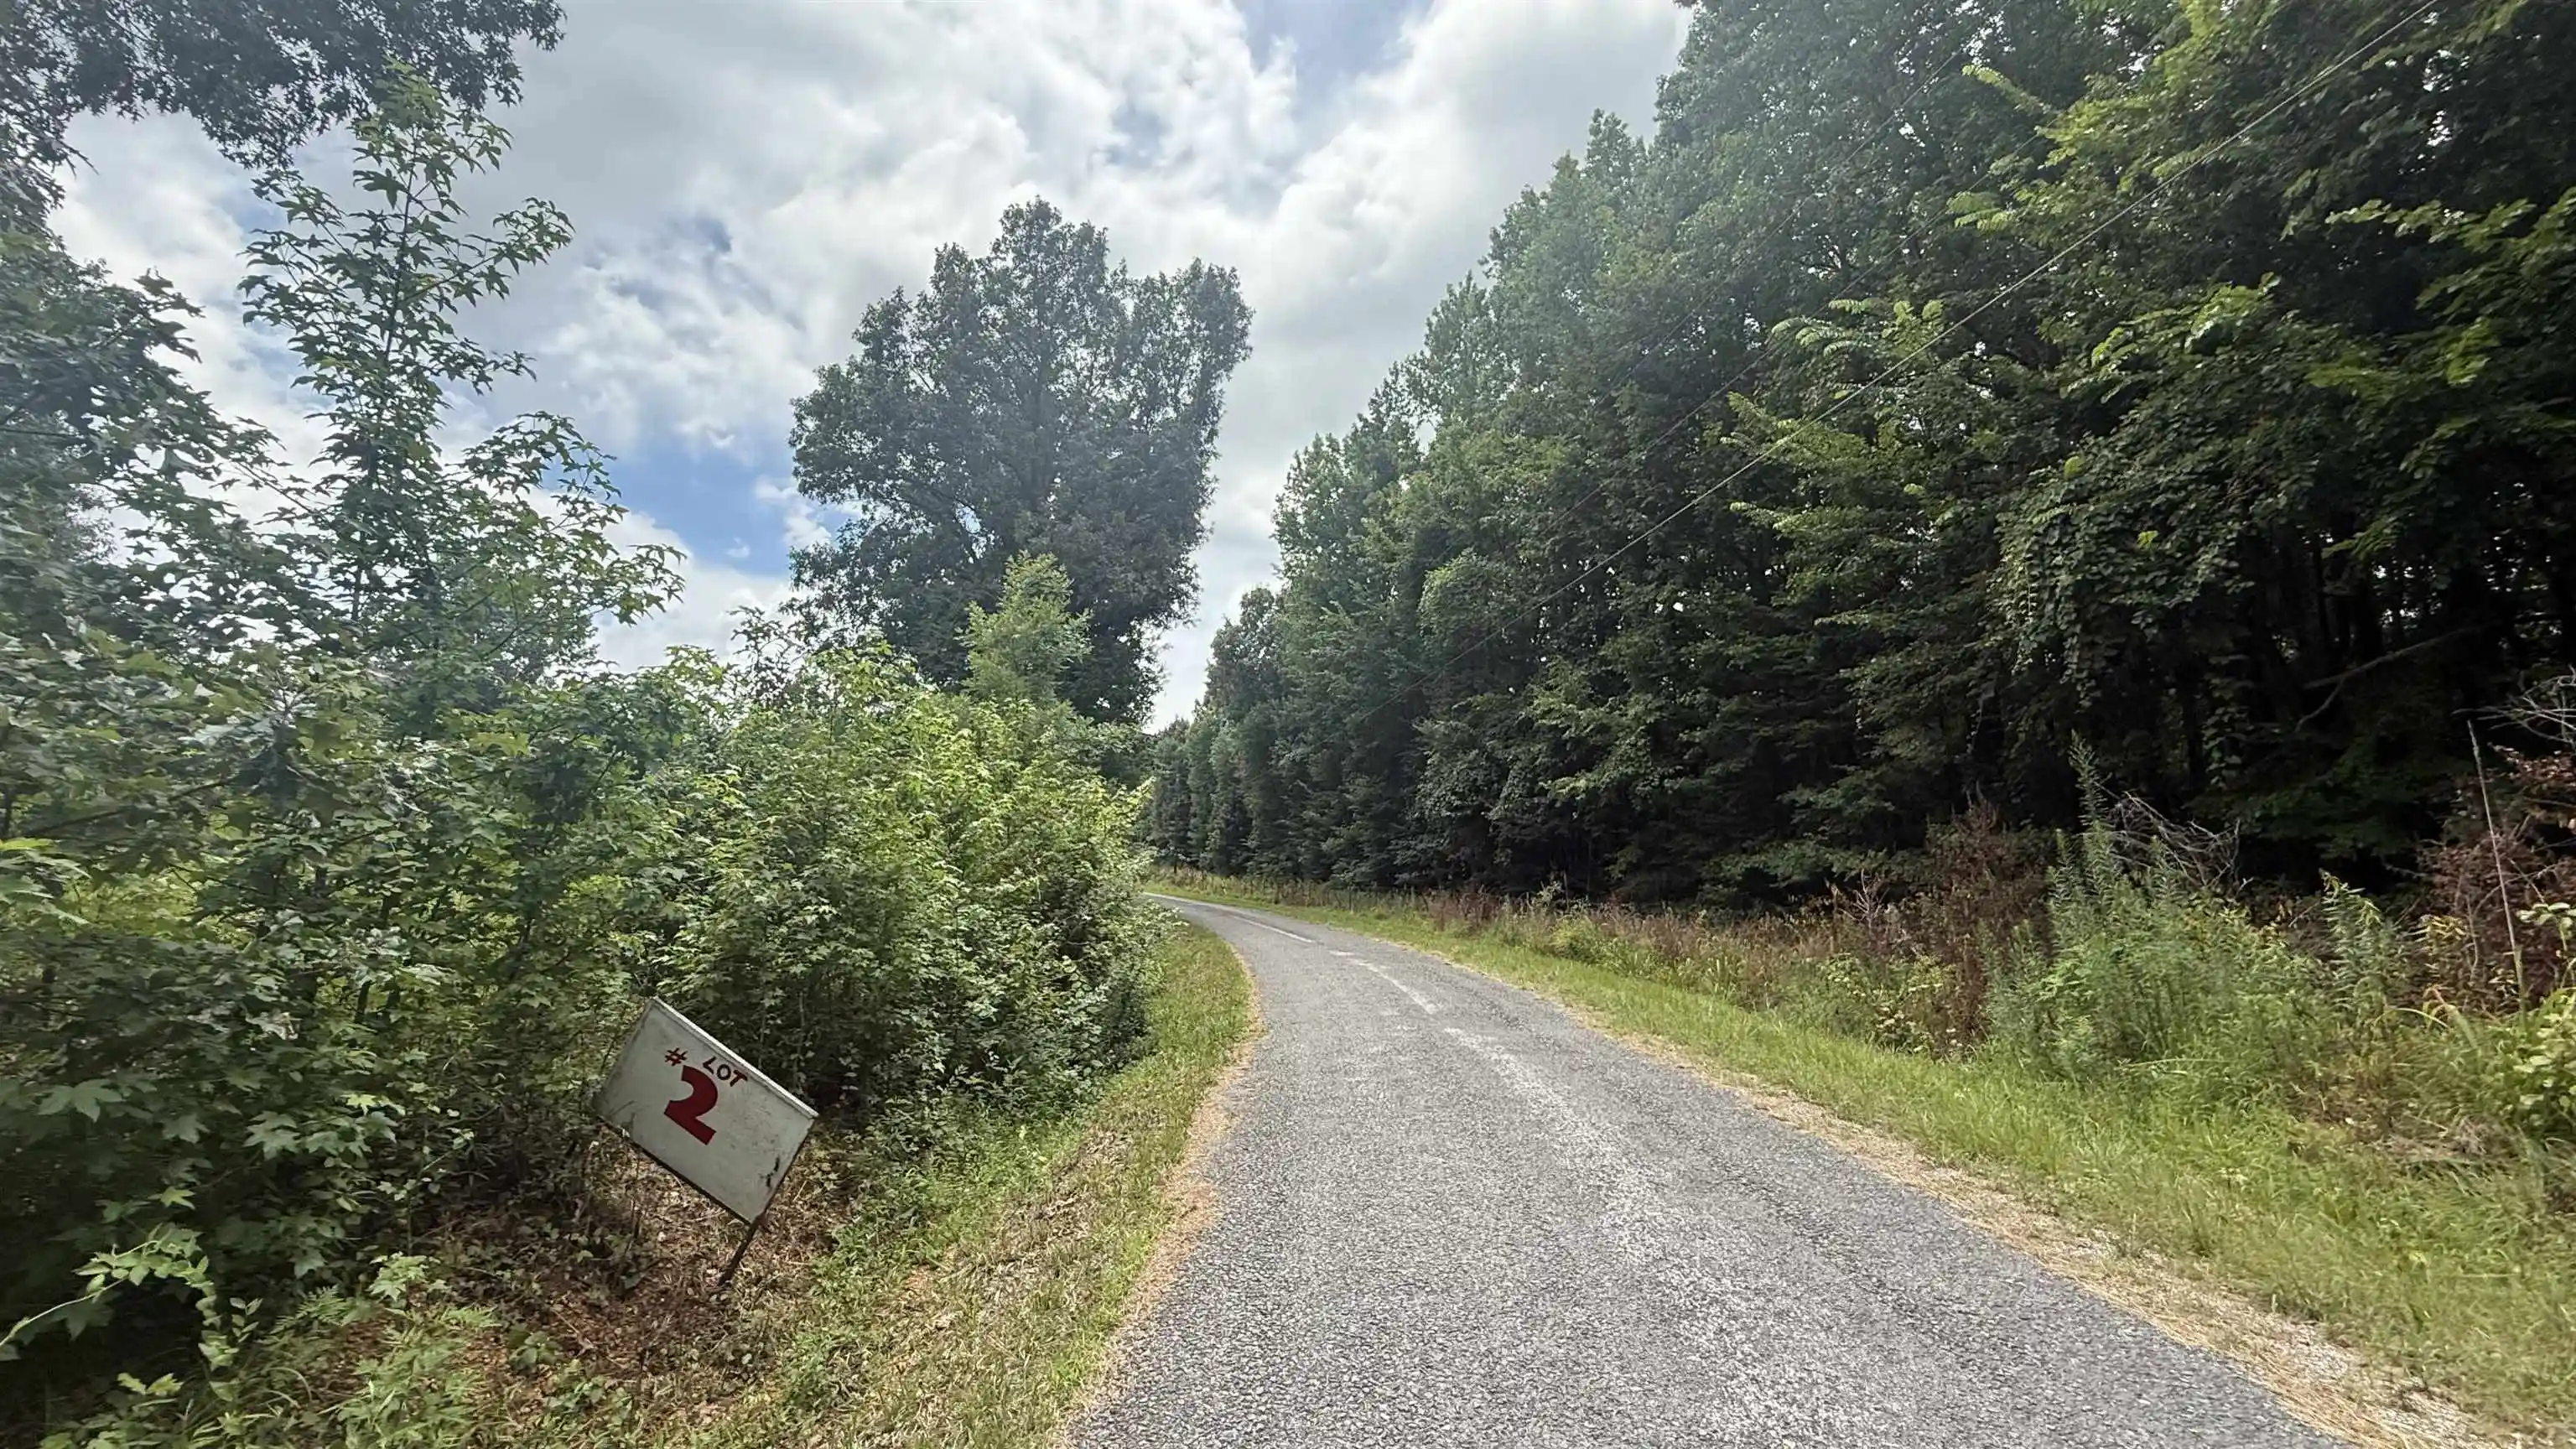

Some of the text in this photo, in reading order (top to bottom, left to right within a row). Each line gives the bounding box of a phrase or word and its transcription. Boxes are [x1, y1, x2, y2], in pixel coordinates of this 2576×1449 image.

[665, 1048, 748, 1087] # LOT
[664, 1065, 717, 1145] 2
